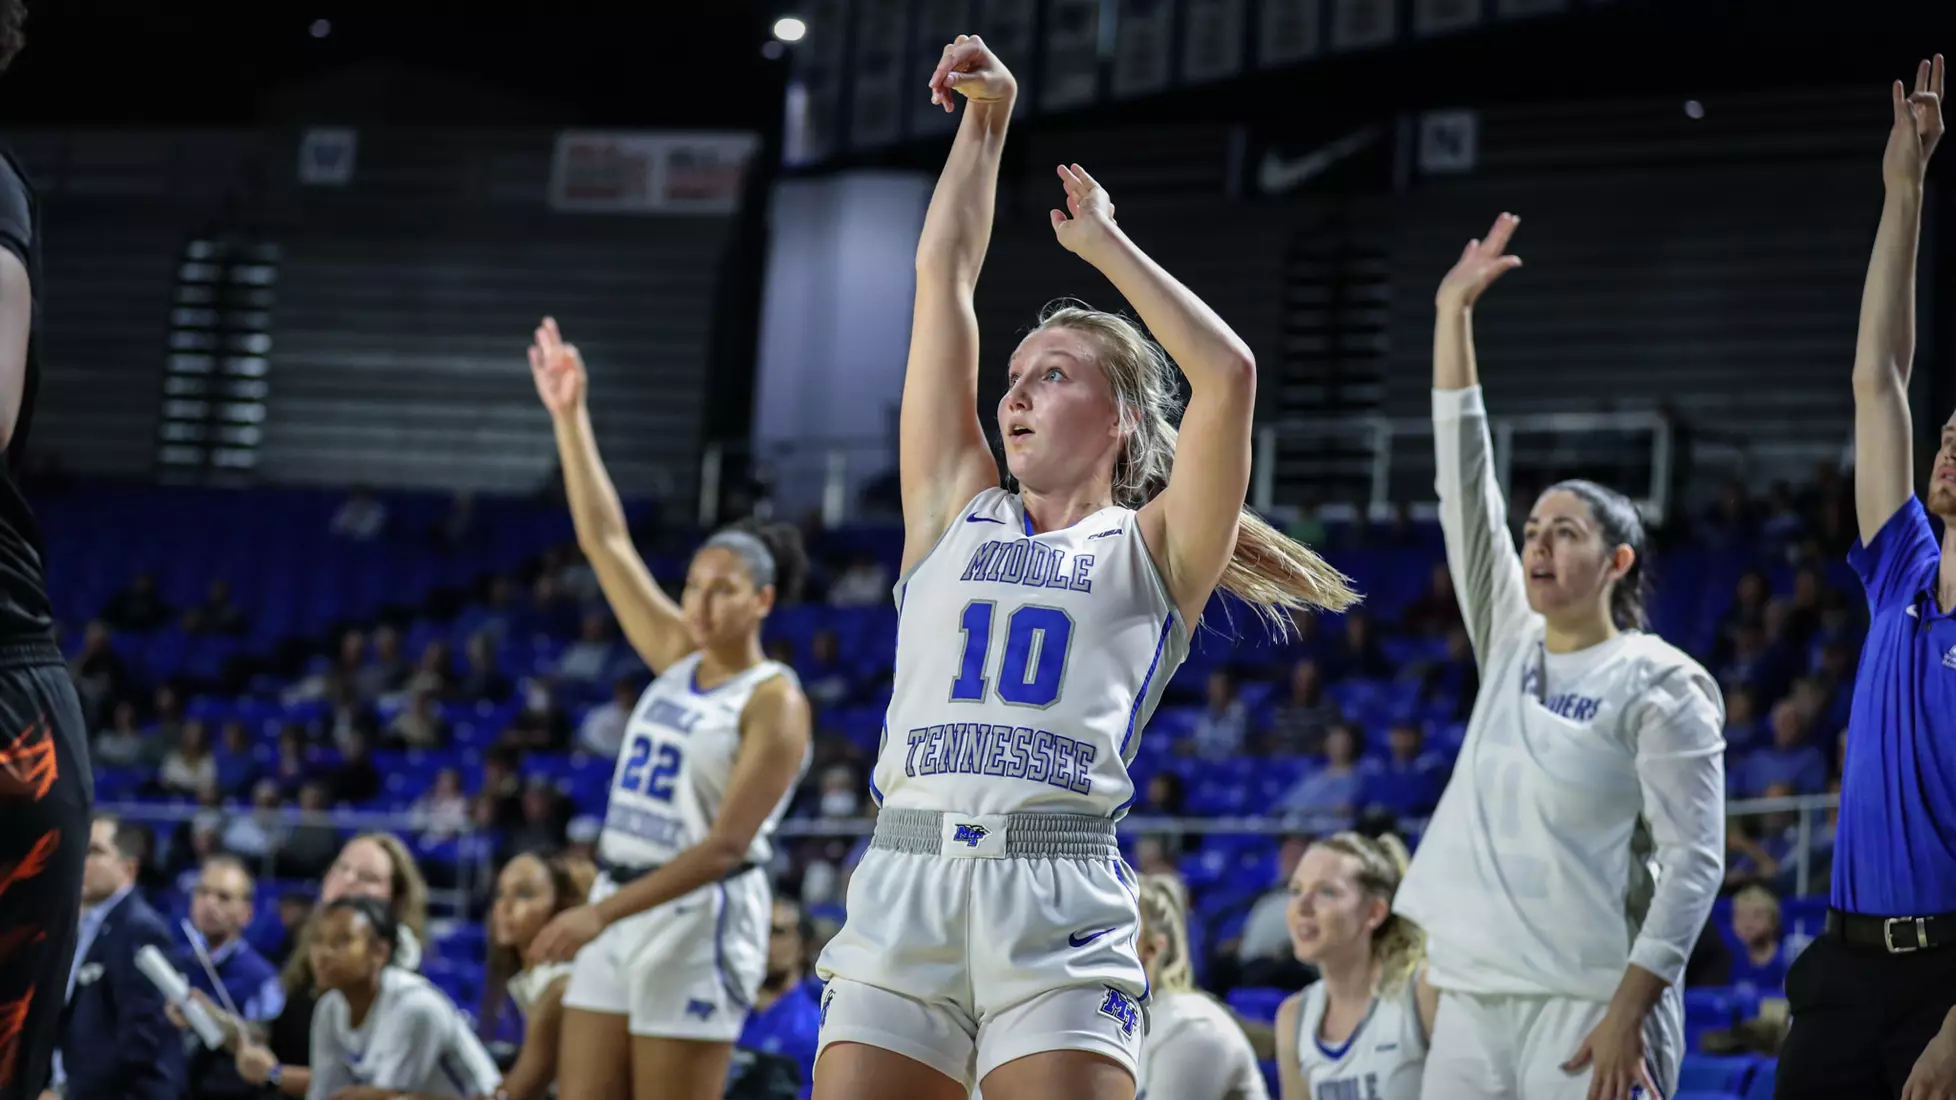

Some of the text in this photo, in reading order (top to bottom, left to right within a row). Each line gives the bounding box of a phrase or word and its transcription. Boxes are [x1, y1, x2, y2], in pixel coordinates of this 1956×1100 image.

[960, 538, 1096, 594] MIDDLE
[948, 598, 1076, 711] 10
[621, 735, 682, 804] 22
[905, 723, 1096, 796] TENNESSEE
[1100, 988, 1138, 1037] MT
